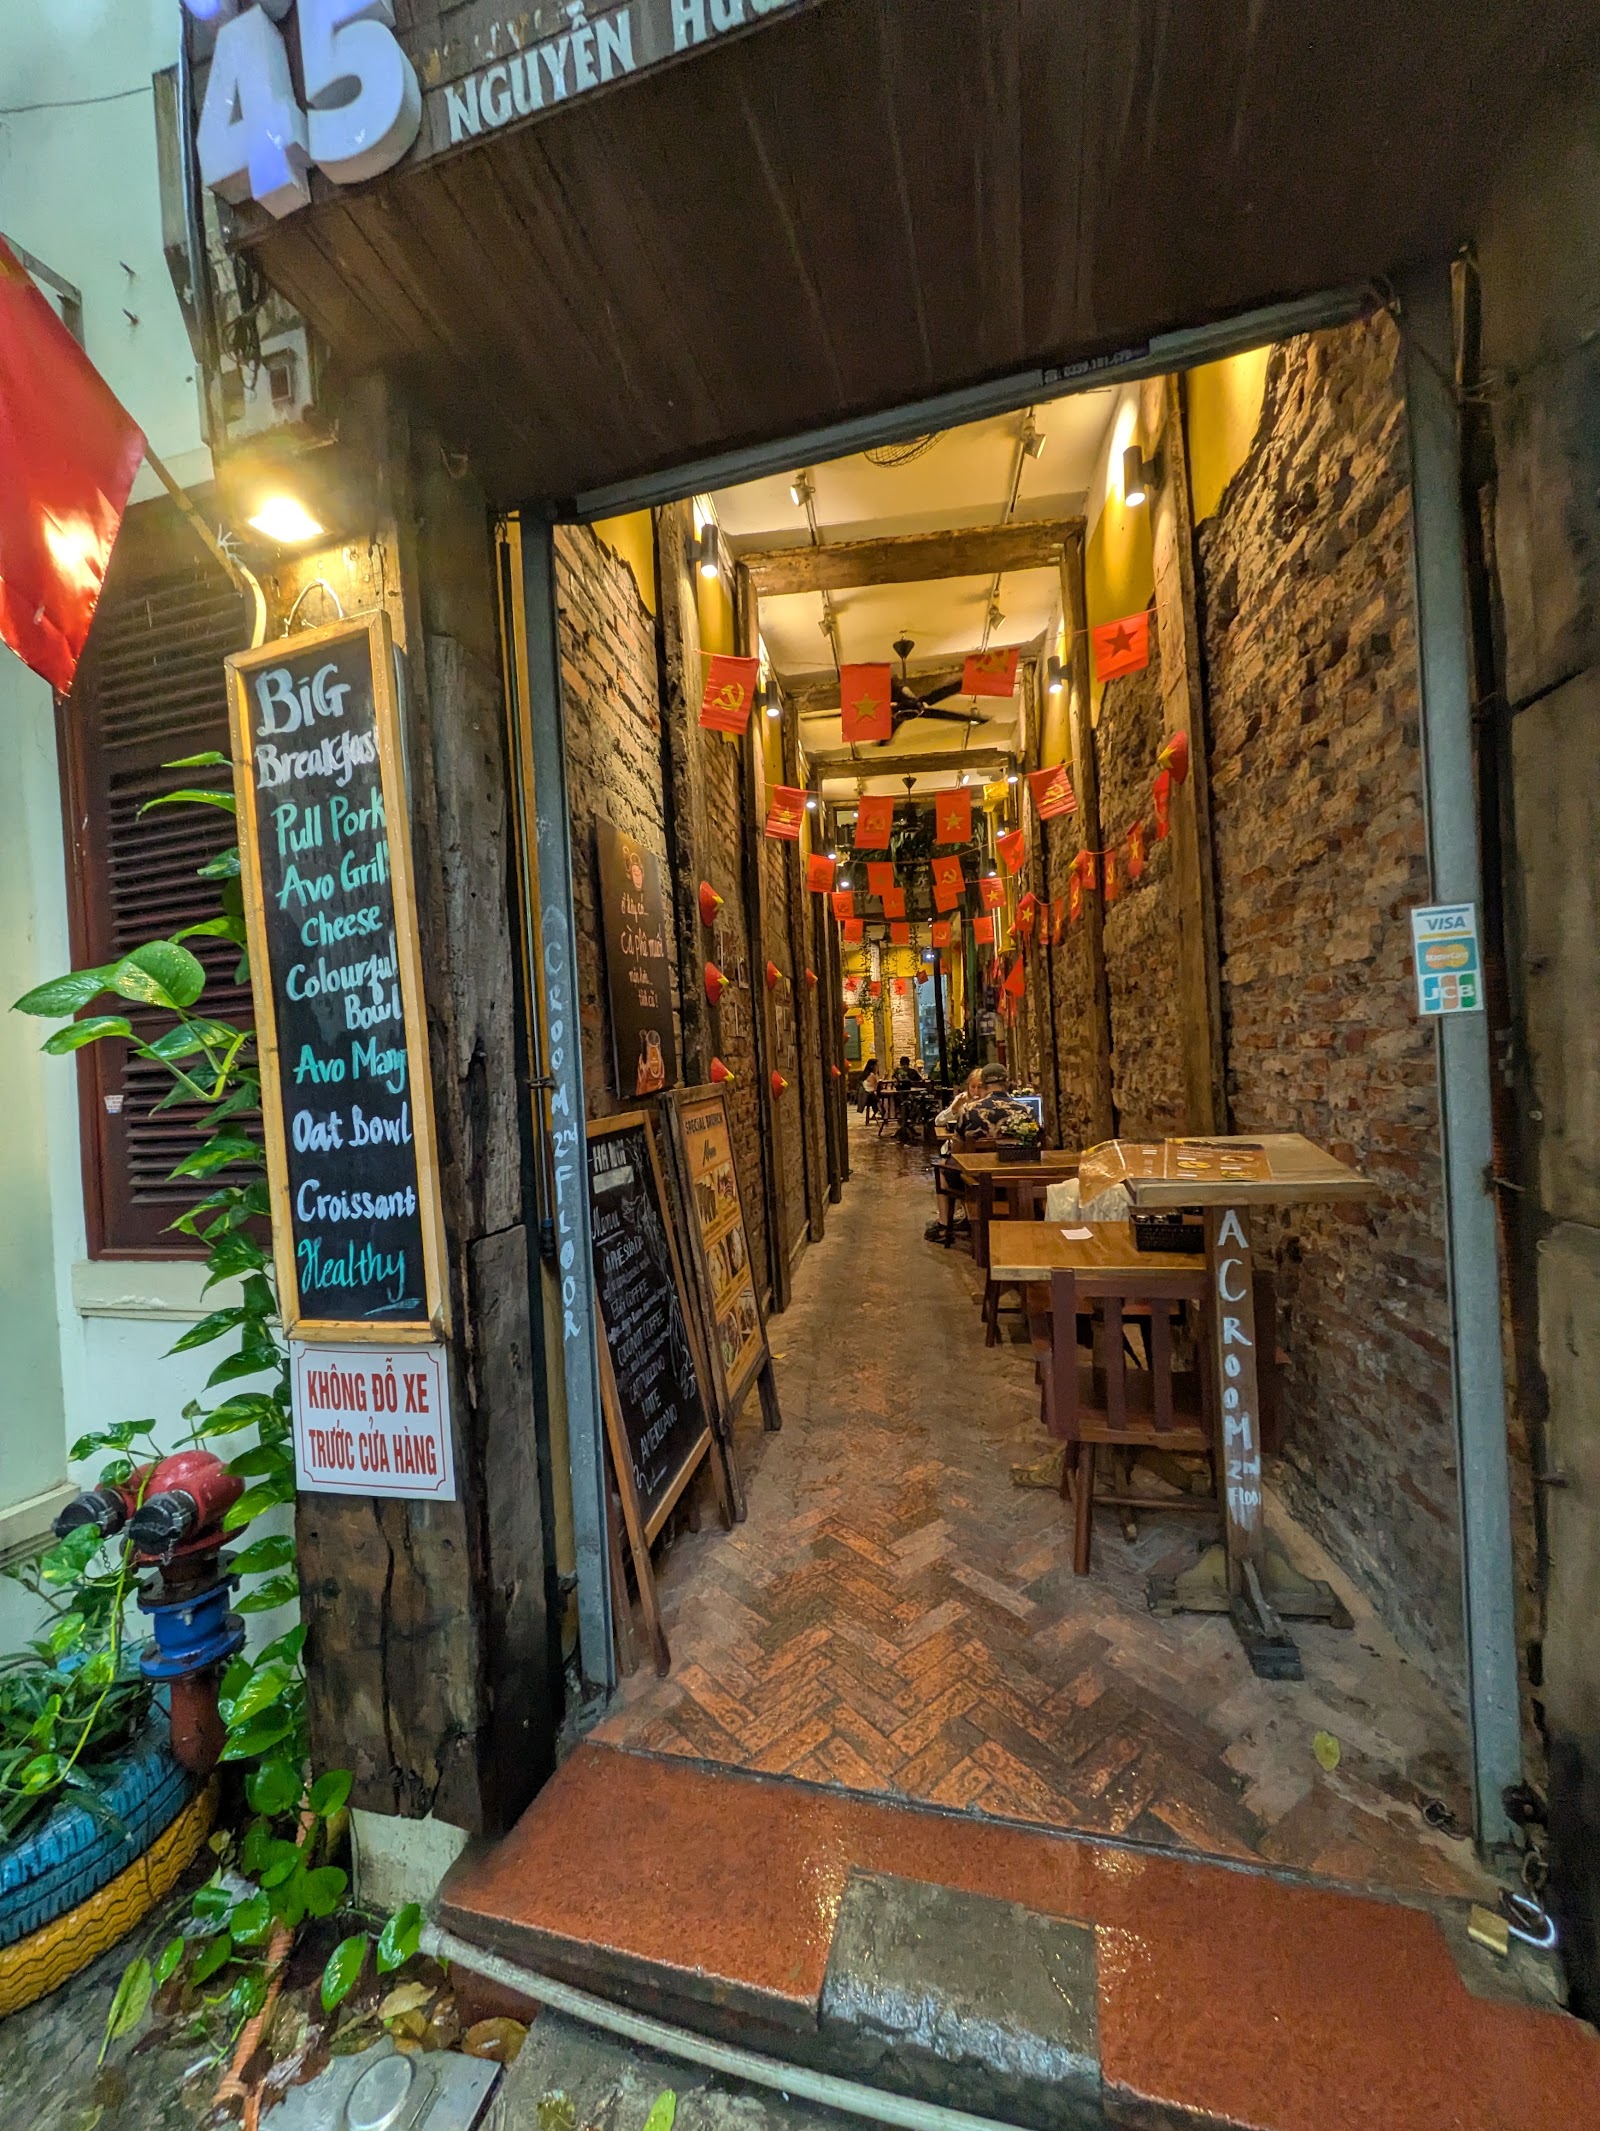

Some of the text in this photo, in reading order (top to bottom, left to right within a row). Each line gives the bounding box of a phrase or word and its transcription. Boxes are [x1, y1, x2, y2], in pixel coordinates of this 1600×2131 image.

[197, 0, 415, 212] 45
[270, 786, 387, 856] Pull Pork
[275, 864, 335, 910] Avo
[1426, 916, 1466, 931] VISA
[286, 932, 399, 1005] Colourful
[344, 983, 402, 1030] Bowl
[293, 1044, 345, 1084] Avo
[292, 1101, 413, 1153] Oat Bowl
[553, 1122, 579, 1158] 2nd
[297, 1178, 416, 1222] Croissant
[297, 1236, 405, 1303] Healthy
[307, 1357, 430, 1413] KHÔNG ĐỖ XE
[308, 1416, 437, 1476] TRƯỚC CỬA HÀNG
